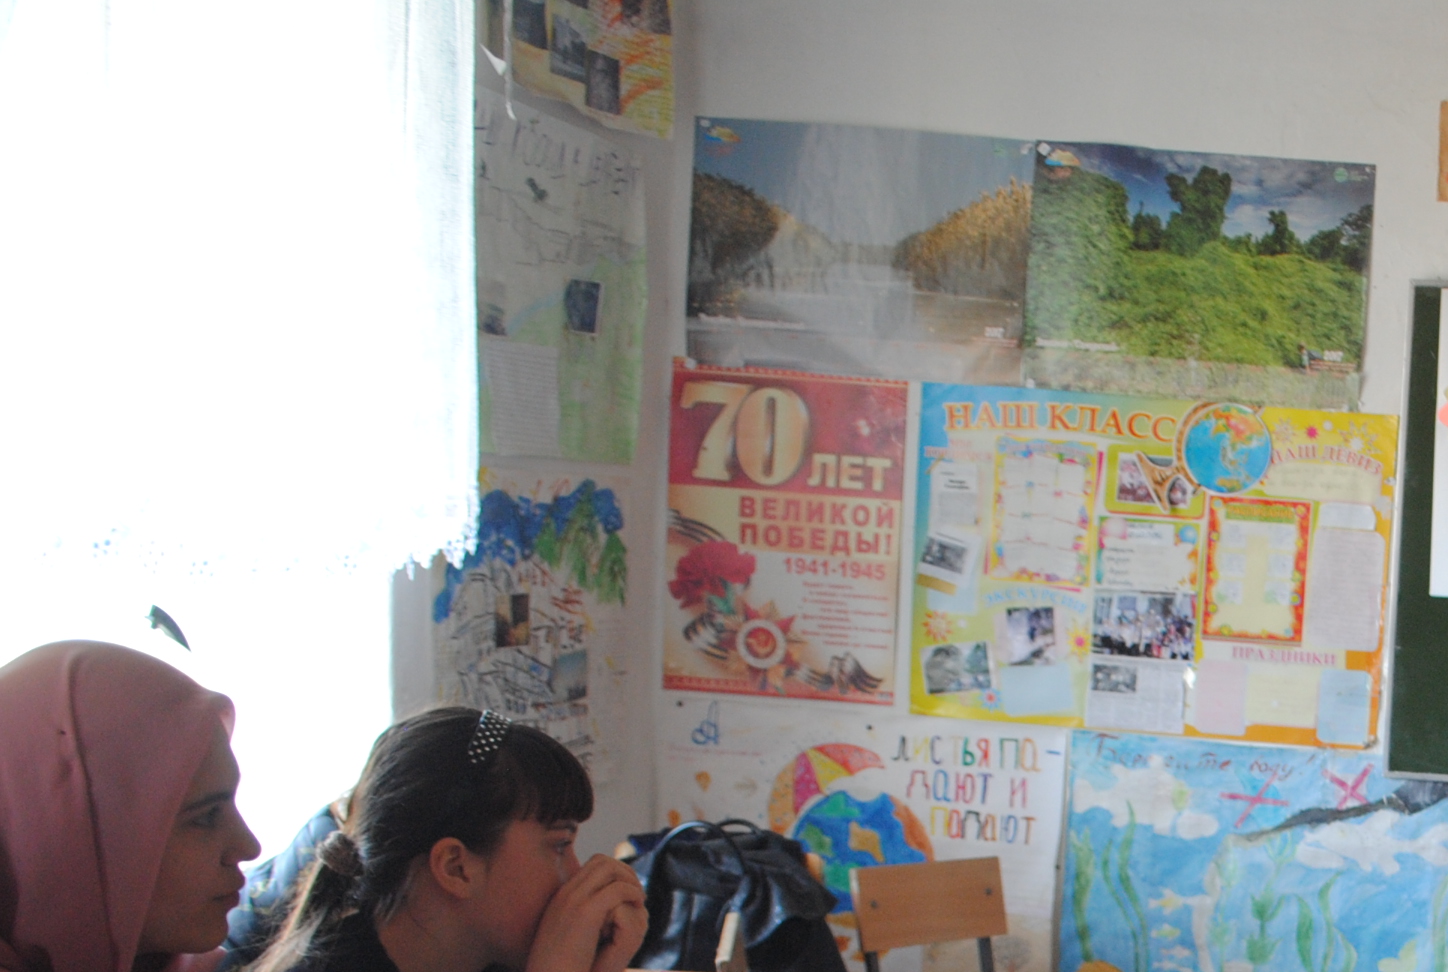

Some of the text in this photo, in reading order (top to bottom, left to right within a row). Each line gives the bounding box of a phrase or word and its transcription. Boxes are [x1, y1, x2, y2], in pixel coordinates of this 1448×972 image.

[679, 381, 893, 492] 70 ЛЕТ
[943, 402, 1177, 443] НАШ КЛАСС
[739, 496, 896, 529] ВЕЛИКОЙ
[739, 522, 893, 556] ПОБЕДЫ!
[783, 557, 887, 581] 1941-1945
